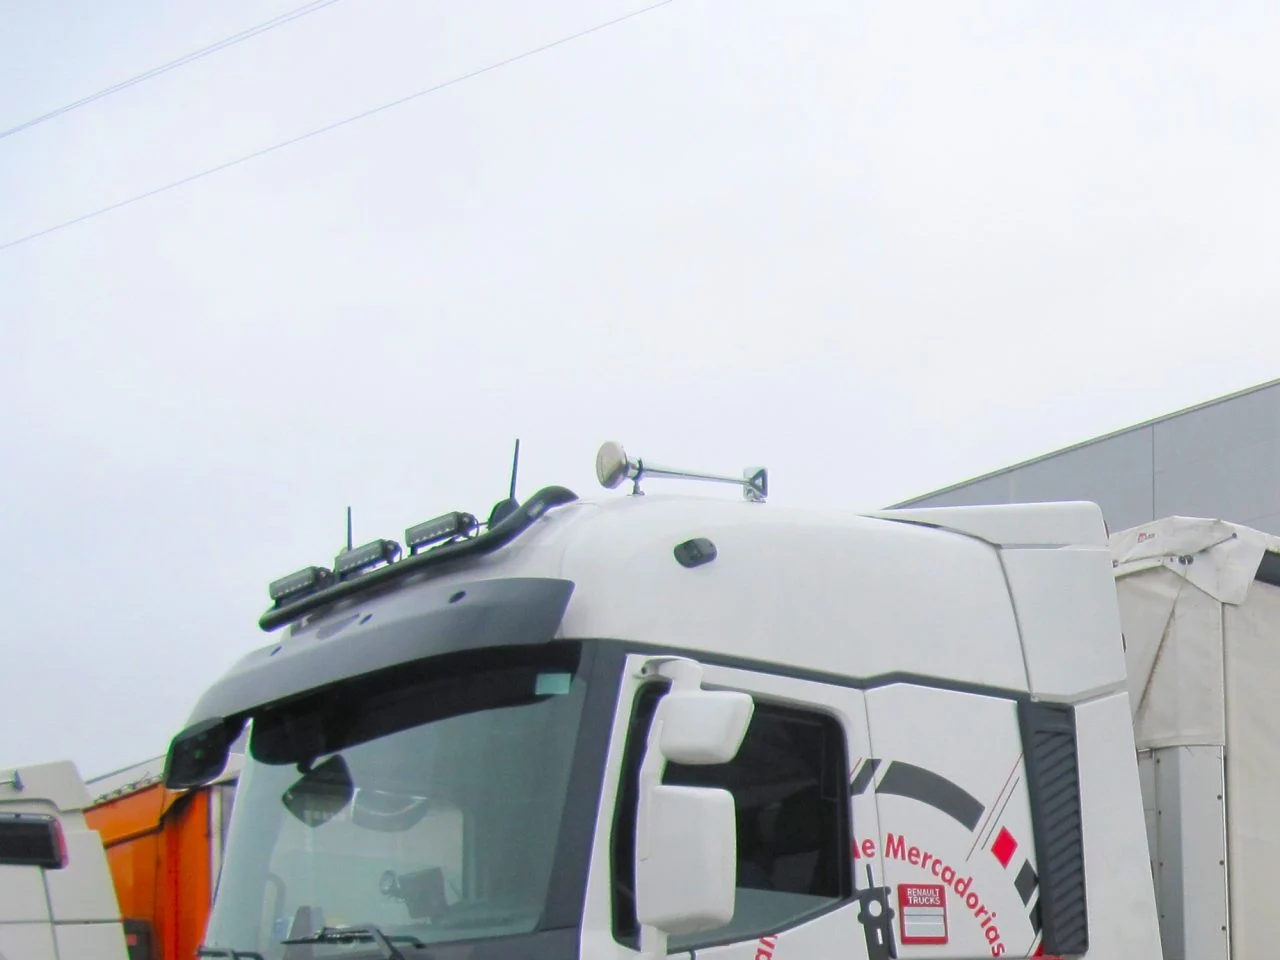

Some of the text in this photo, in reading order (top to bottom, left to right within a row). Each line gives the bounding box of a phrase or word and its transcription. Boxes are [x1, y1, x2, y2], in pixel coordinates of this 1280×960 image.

[884, 832, 1007, 958] Mercadorias
[907, 888, 940, 897] RENAULT
[908, 896, 941, 905] TRUCKS
